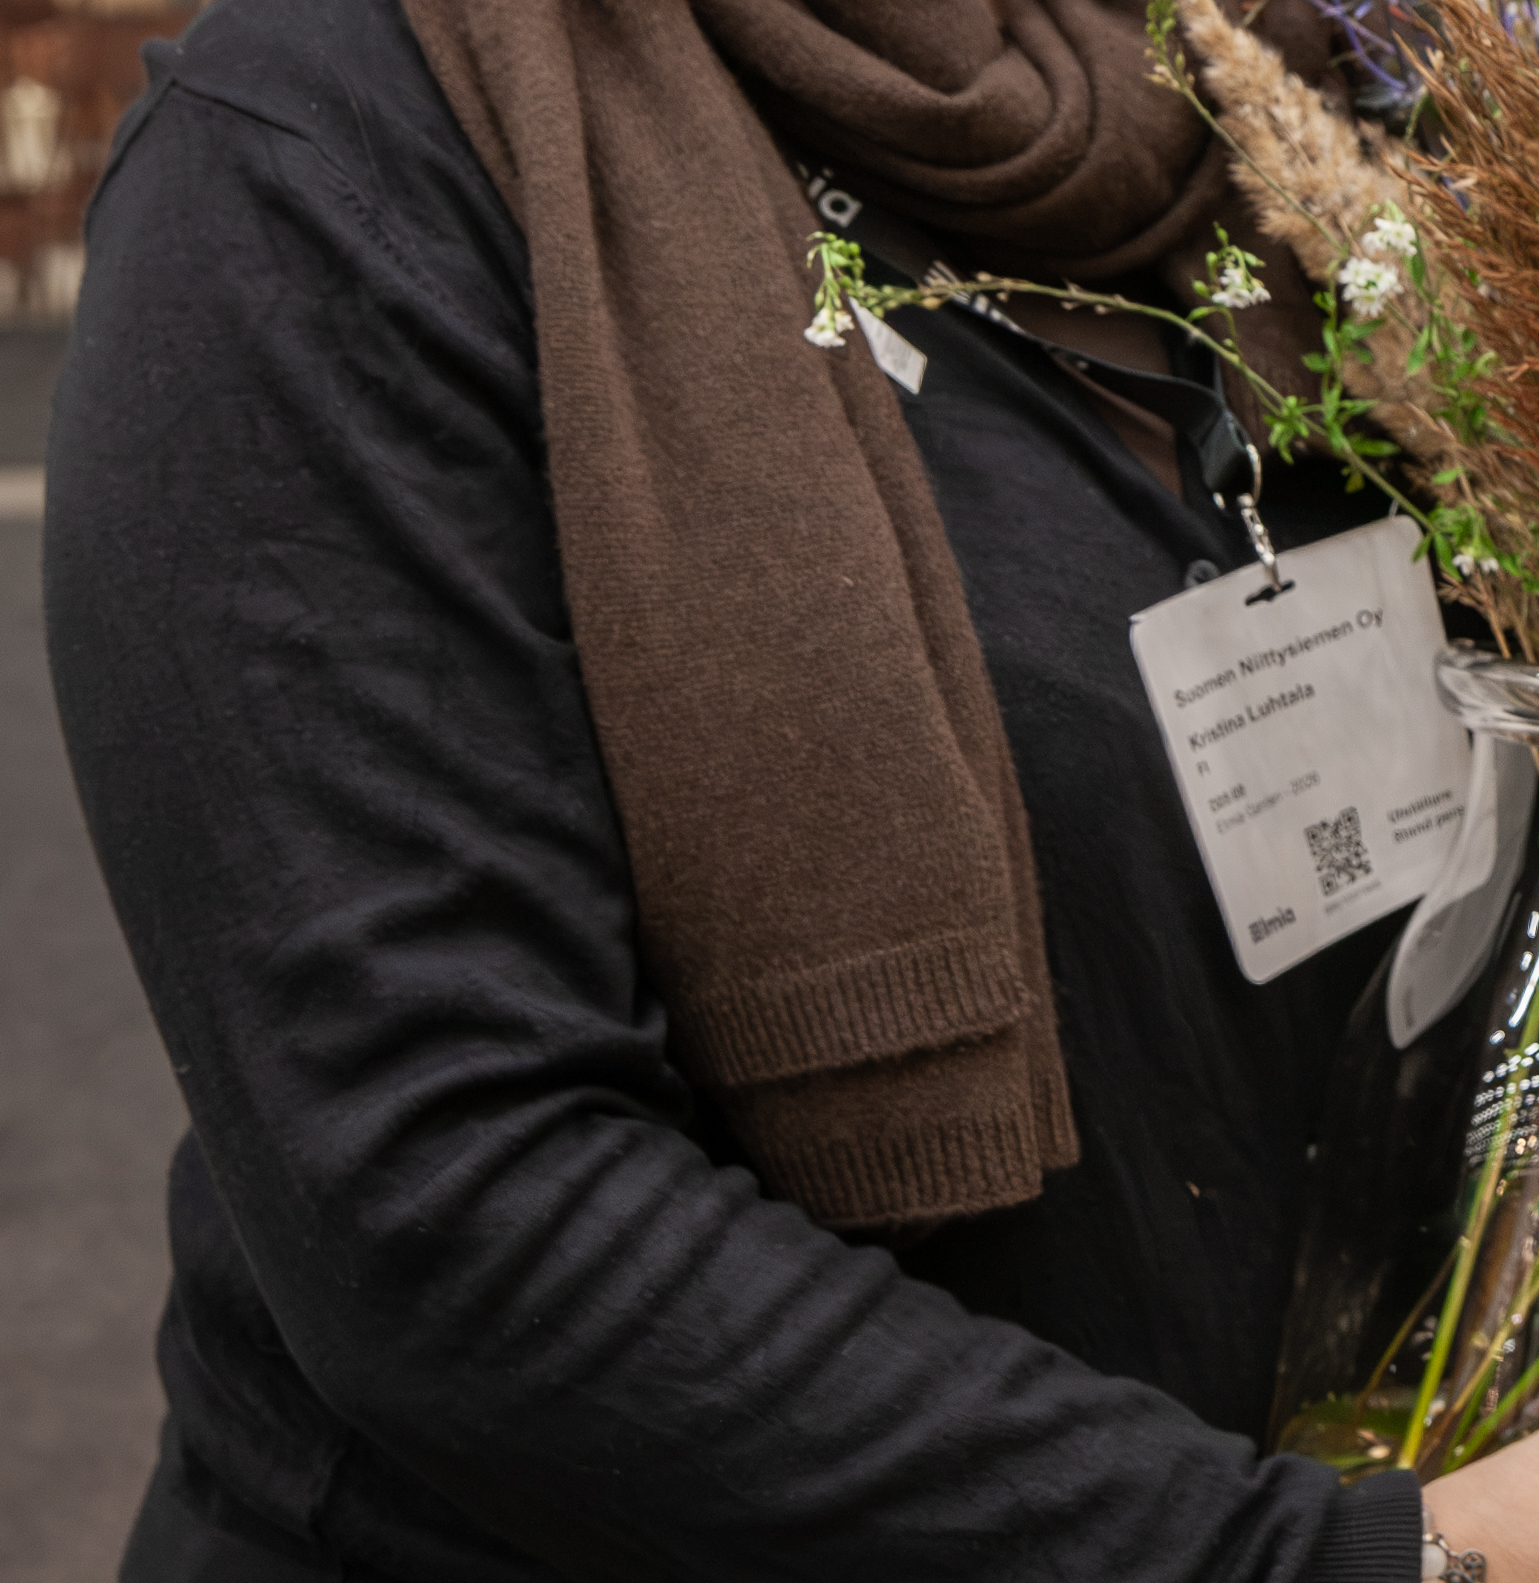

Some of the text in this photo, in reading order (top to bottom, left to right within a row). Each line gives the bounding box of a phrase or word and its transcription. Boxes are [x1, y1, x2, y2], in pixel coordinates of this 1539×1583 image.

[1173, 607, 1384, 709] Suomen Niittysiemen Oy
[1187, 682, 1316, 753] Kristina Luhtala
[1248, 906, 1297, 945] Elmia
